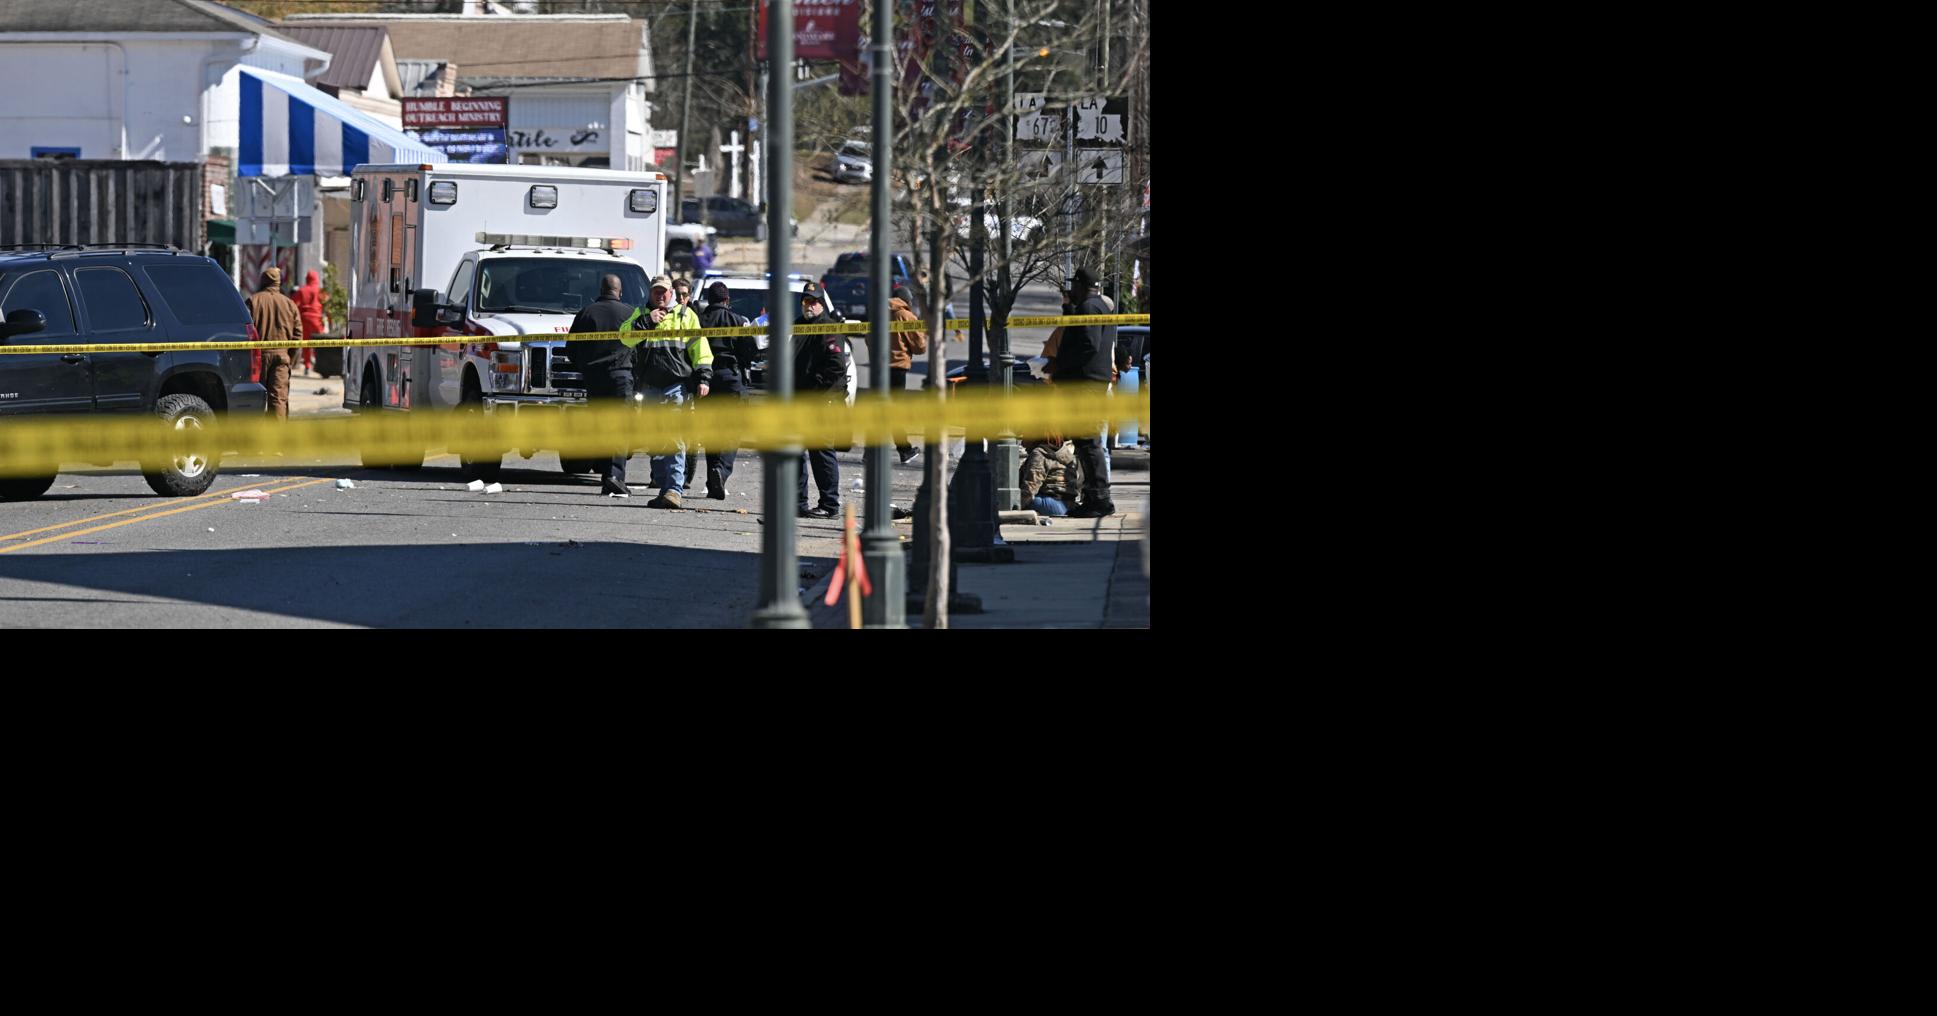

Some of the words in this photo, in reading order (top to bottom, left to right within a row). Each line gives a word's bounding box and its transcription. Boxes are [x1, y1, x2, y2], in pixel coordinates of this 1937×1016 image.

[405, 101, 446, 111] HUMBLE
[450, 101, 502, 111] BEGINNING
[1081, 97, 1098, 110] LA
[405, 112, 457, 123] OUTREACH
[458, 112, 501, 122] MINISTRY
[1033, 118, 1049, 135] 67
[1095, 116, 1108, 134] 10
